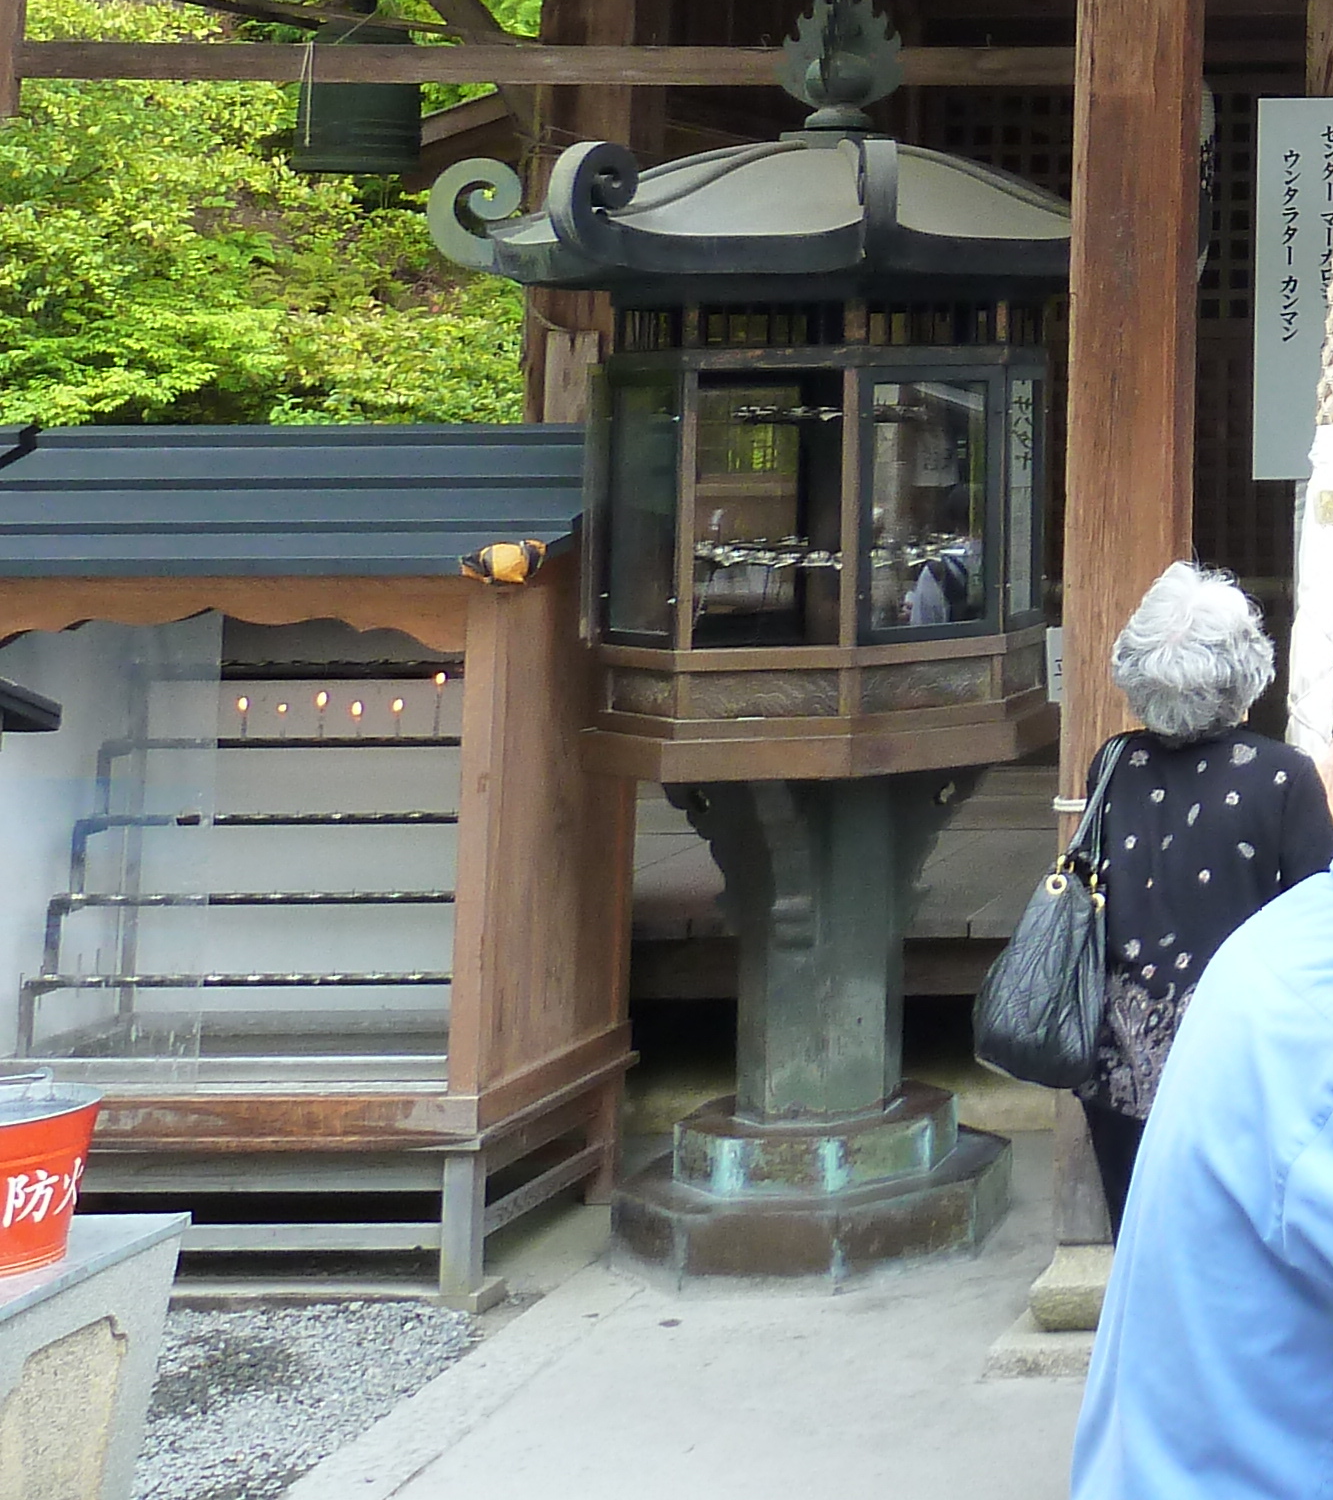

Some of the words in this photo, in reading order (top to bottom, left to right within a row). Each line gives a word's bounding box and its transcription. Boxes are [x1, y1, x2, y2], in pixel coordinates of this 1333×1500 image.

[1282, 149, 1301, 266] ウンタラター
[1280, 274, 1299, 342] カンマン
